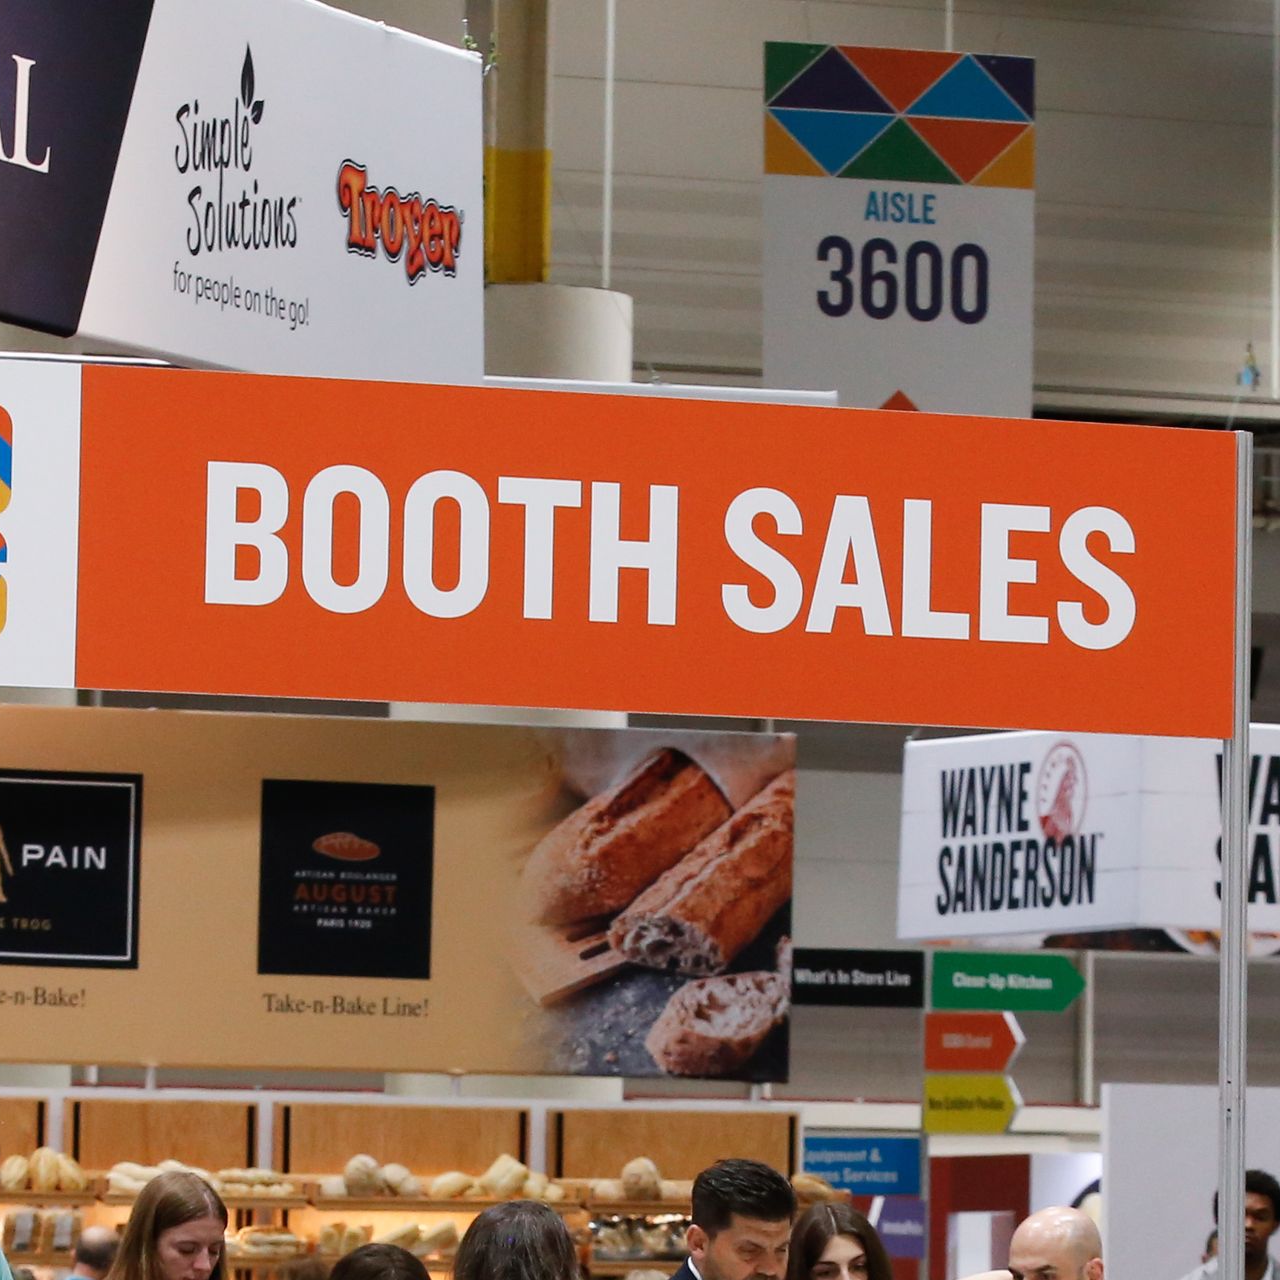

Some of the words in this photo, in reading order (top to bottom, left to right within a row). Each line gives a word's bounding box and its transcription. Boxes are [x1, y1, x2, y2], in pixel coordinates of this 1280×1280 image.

[175, 97, 253, 174] Simple
[186, 179, 298, 256] Solutions
[336, 158, 462, 286] Troyer
[864, 190, 937, 225] AISLE
[173, 260, 193, 295] for
[195, 272, 242, 311] people
[245, 287, 262, 313] on
[264, 286, 287, 321] the
[289, 298, 310, 331] go!
[816, 235, 990, 325] 3600
[204, 460, 679, 627] BOOTH
[721, 487, 1137, 651] SALES
[941, 761, 1031, 839] WAYNE
[21, 843, 107, 870] PAIN
[295, 883, 399, 905] AUGUST
[936, 832, 1098, 916] SANDERSON
[262, 992, 377, 1017] Take-n-Bake
[382, 996, 430, 1018] Line!
